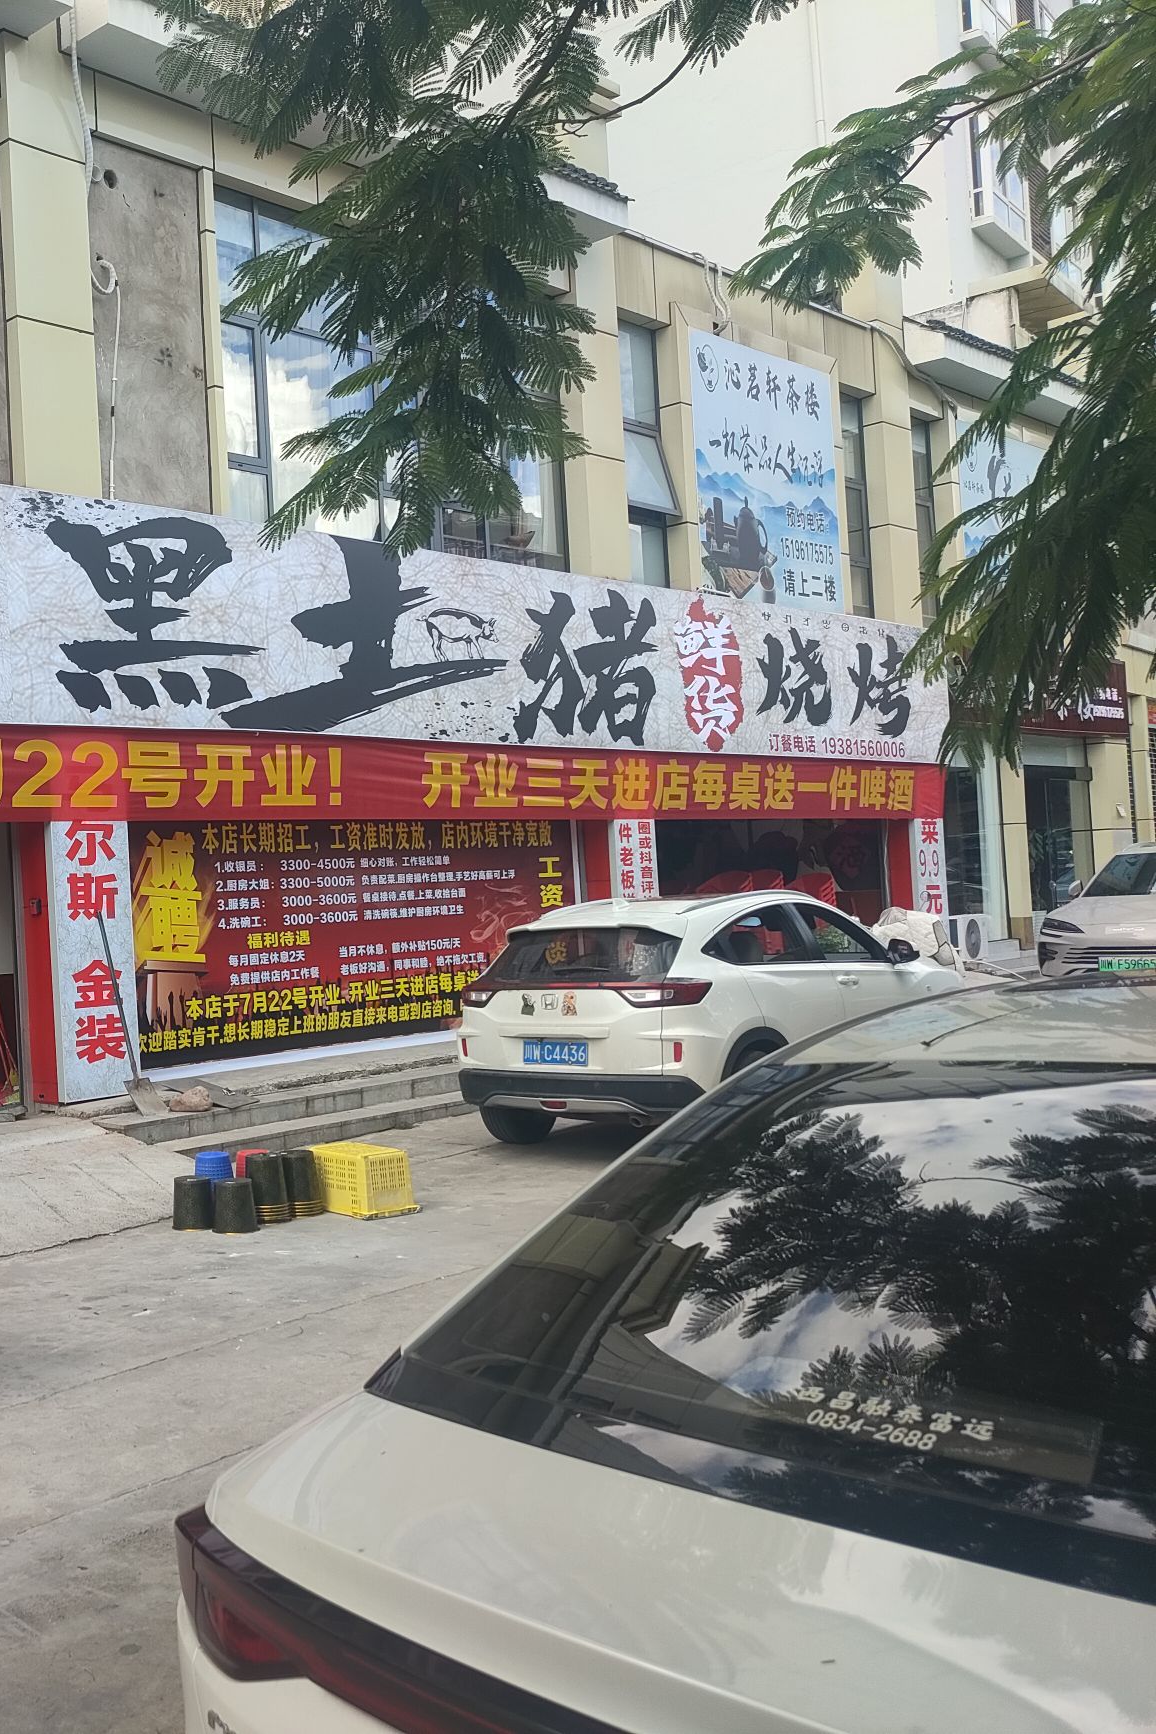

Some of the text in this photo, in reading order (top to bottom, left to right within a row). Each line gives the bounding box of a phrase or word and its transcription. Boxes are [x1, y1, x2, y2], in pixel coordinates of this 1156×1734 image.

[780, 536, 834, 566] 15196175575
[782, 568, 837, 603] 请上二楼
[46, 516, 659, 746] 黑土猪
[674, 614, 740, 744] 鲜货
[756, 627, 912, 739] 烧烤
[769, 733, 906, 758] 订餐电话 19381560006
[422, 751, 914, 813] 开业三天进店每桌送一件啤酒
[280, 857, 355, 871] 3300-4500元
[619, 823, 636, 898] 件老板
[637, 821, 655, 898] 圈或抖音评
[280, 875, 355, 889] 3300-5000元
[140, 830, 206, 963] 诚聘
[281, 893, 357, 908] 3000-3600元
[283, 910, 358, 926] 3000-3600元
[247, 930, 311, 949] 福利待遇
[228, 950, 306, 967] 每月固定休息2天
[230, 966, 320, 986] 免费提供店内工作餐
[806, 1409, 937, 1450] 0834-2688
